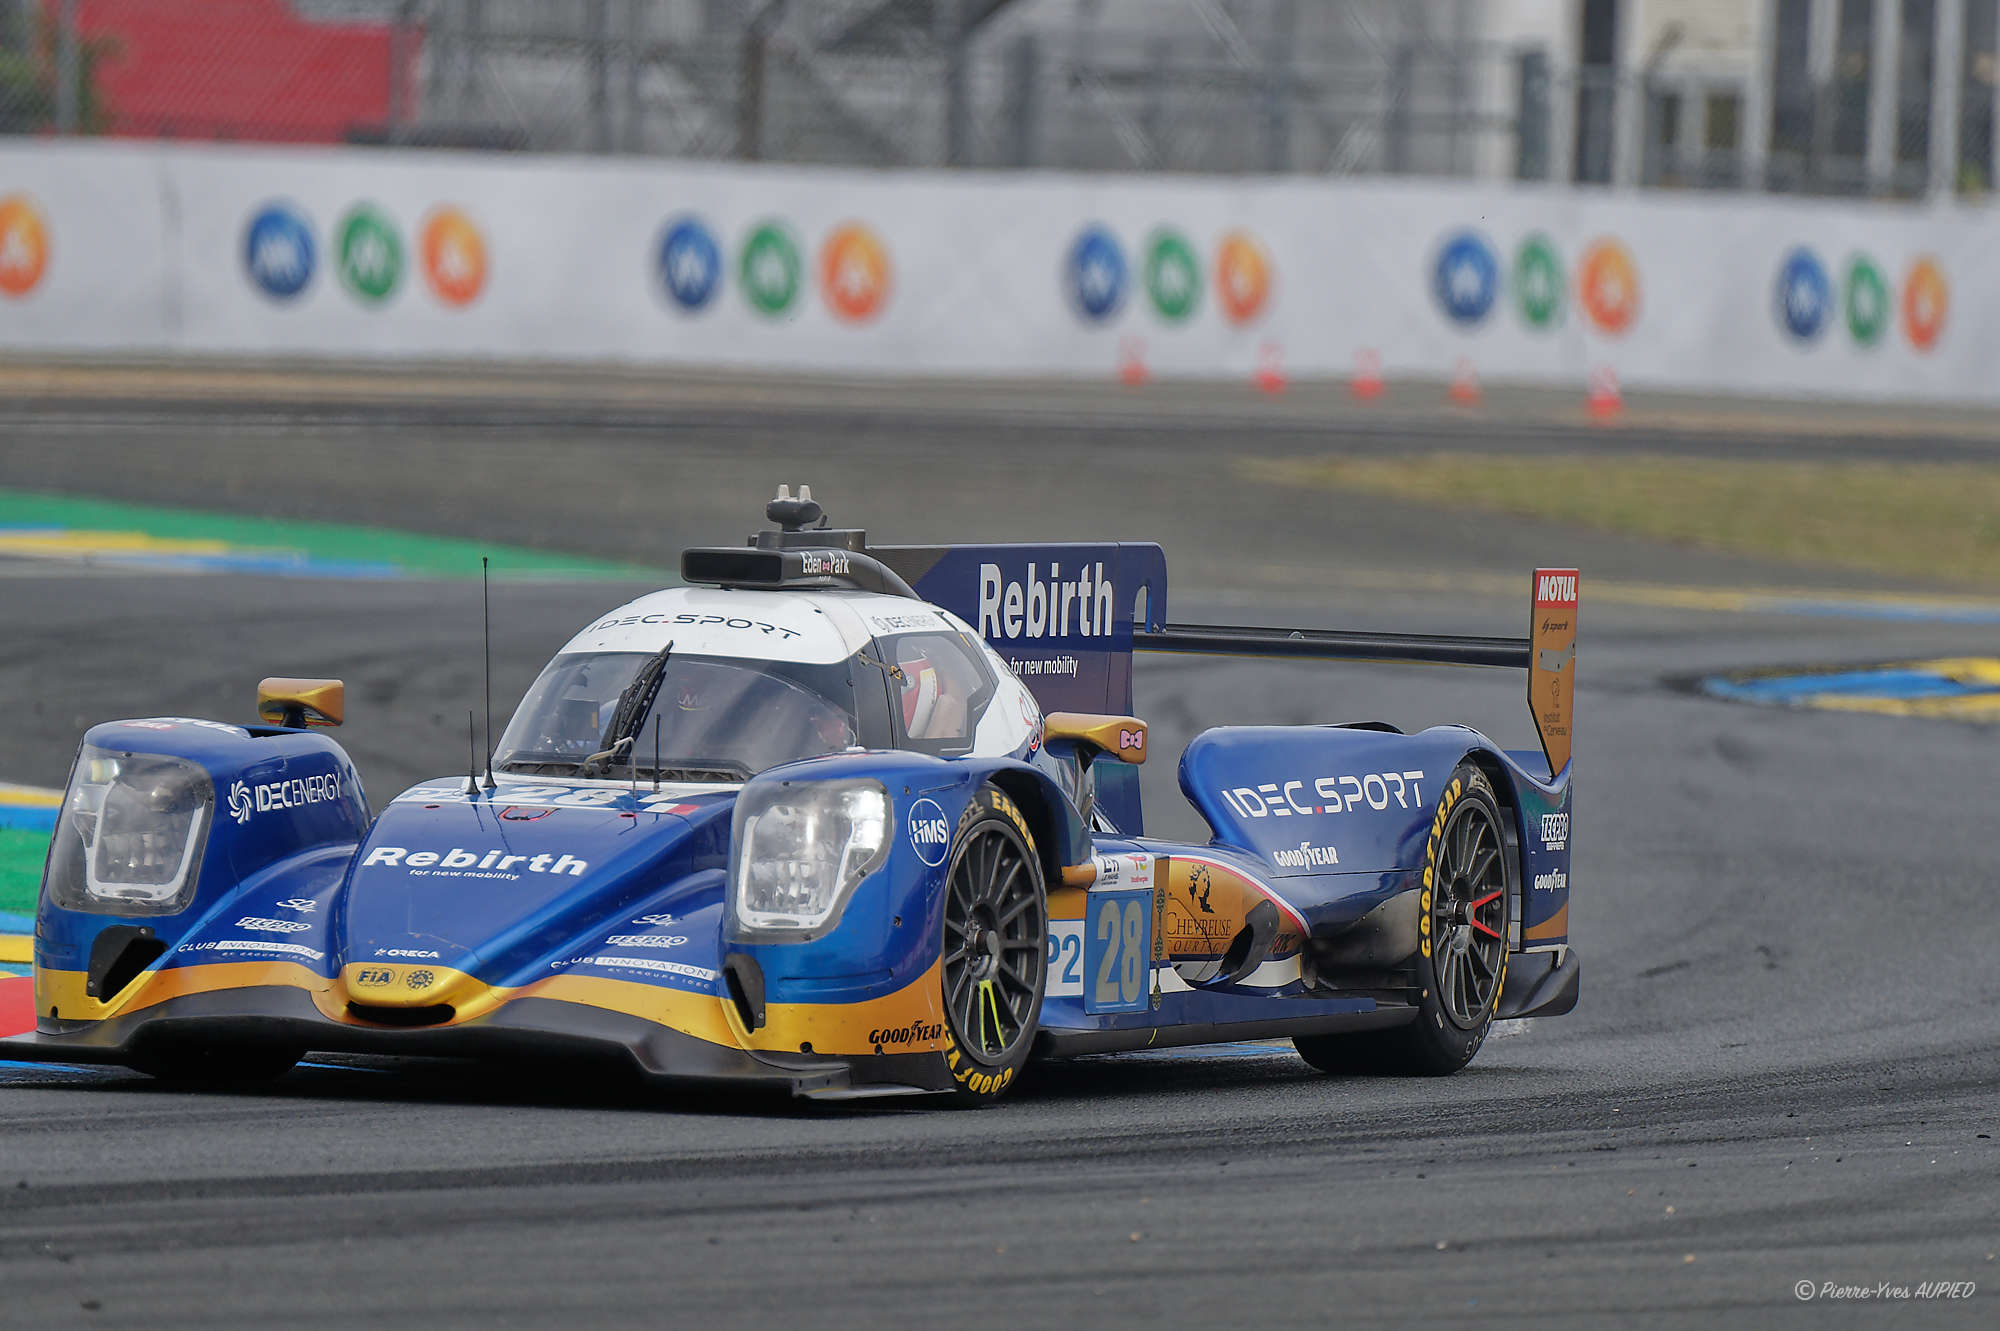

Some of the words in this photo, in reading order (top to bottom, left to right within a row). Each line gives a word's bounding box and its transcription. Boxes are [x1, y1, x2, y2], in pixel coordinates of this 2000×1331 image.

[801, 552, 822, 574] Eden
[829, 551, 850, 574] Park
[978, 562, 1113, 639] Rebirth
[1538, 575, 1577, 601] MOTUL
[588, 614, 801, 640] IDEC.SPORT
[1010, 656, 1023, 675] for
[1024, 660, 1043, 675] new
[1044, 655, 1078, 678] mobility
[1222, 770, 1424, 818] IDEC.SPORT
[911, 819, 947, 844] HMS
[363, 847, 589, 876] Rebirth
[1273, 842, 1339, 871] GOODYEAR
[1421, 778, 1461, 958] GOODYEAR
[463, 871, 520, 881] mobility
[178, 942, 218, 953] CLUB
[387, 949, 440, 959] ORECA
[1095, 900, 1143, 1003] 28
[601, 958, 710, 978] INNOVATION
[869, 1019, 942, 1047] GOODYEAR
